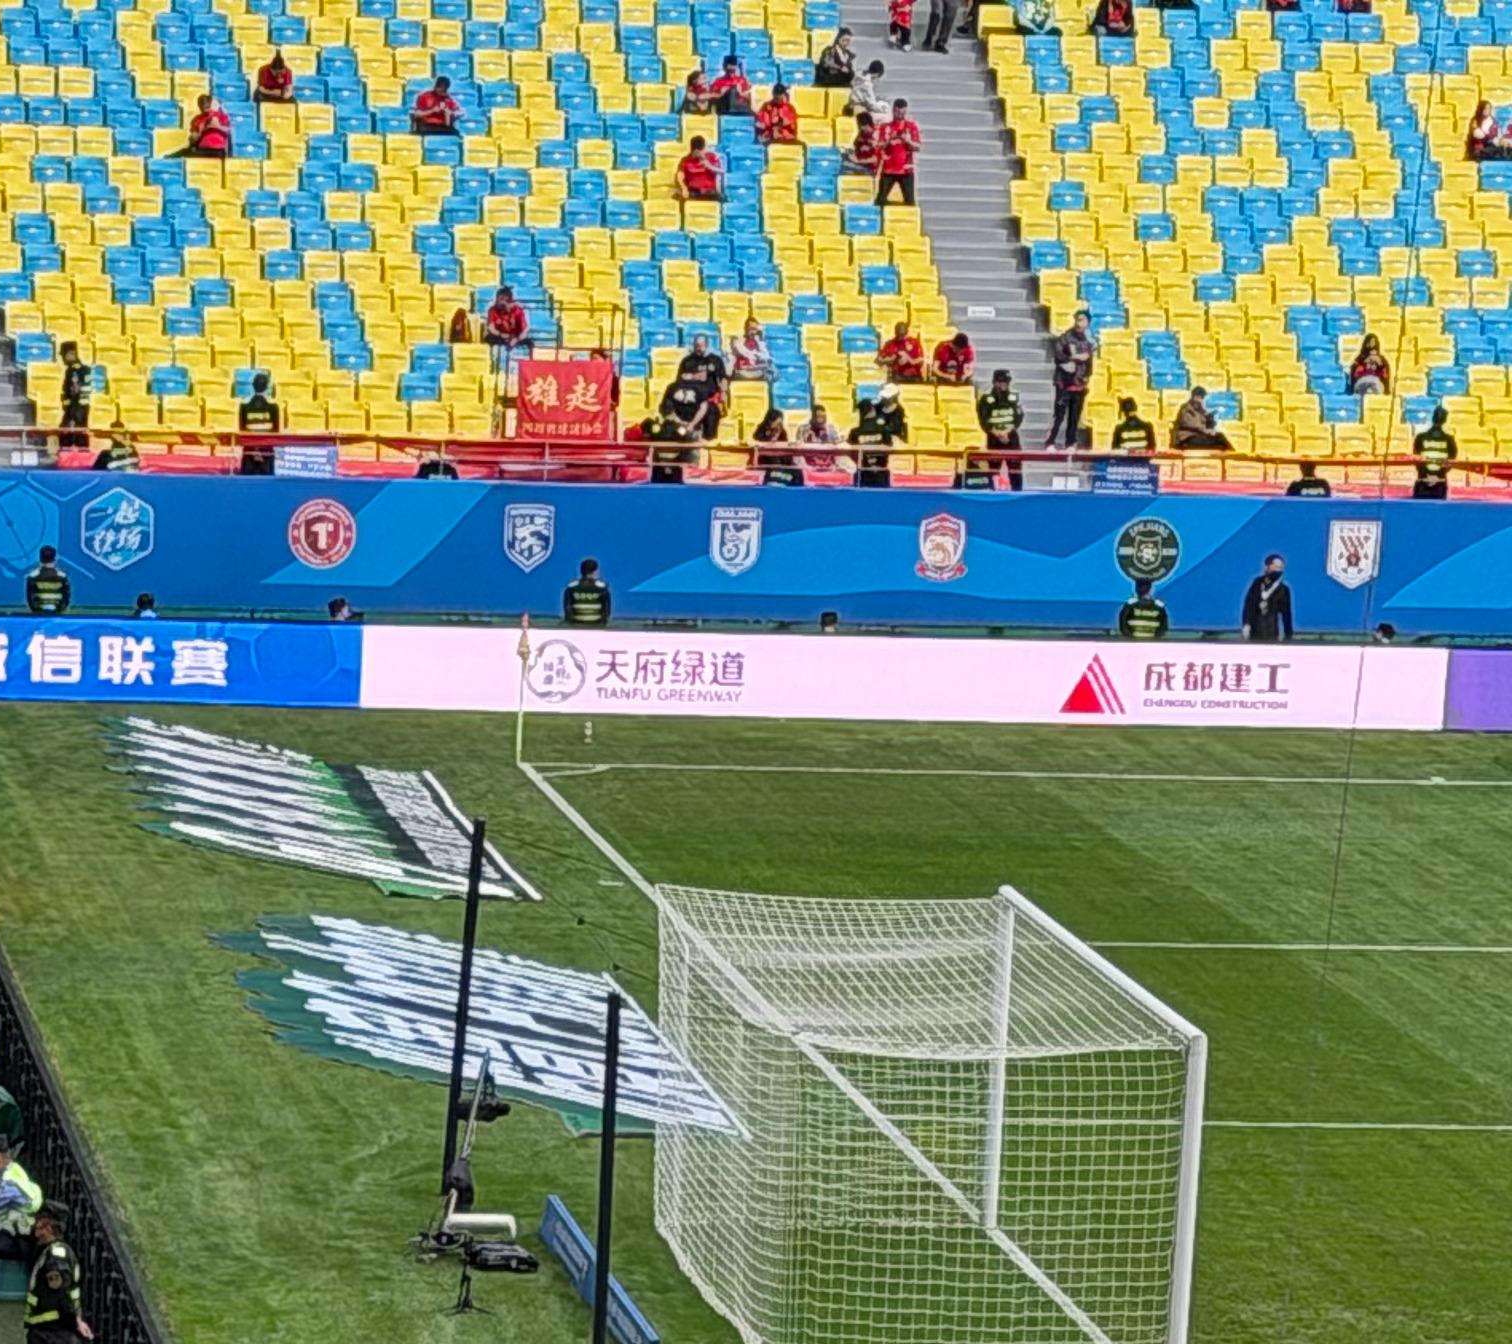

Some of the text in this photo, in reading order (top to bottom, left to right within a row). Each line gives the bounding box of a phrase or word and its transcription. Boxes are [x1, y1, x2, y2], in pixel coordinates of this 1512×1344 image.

[525, 374, 603, 413] 雄起
[595, 648, 746, 687] 天府绿道
[1143, 661, 1291, 694] 成都建工
[596, 687, 743, 703] TIANFU GREENWAY
[1143, 698, 1289, 711] CHENGDU CONSTRUCTION
